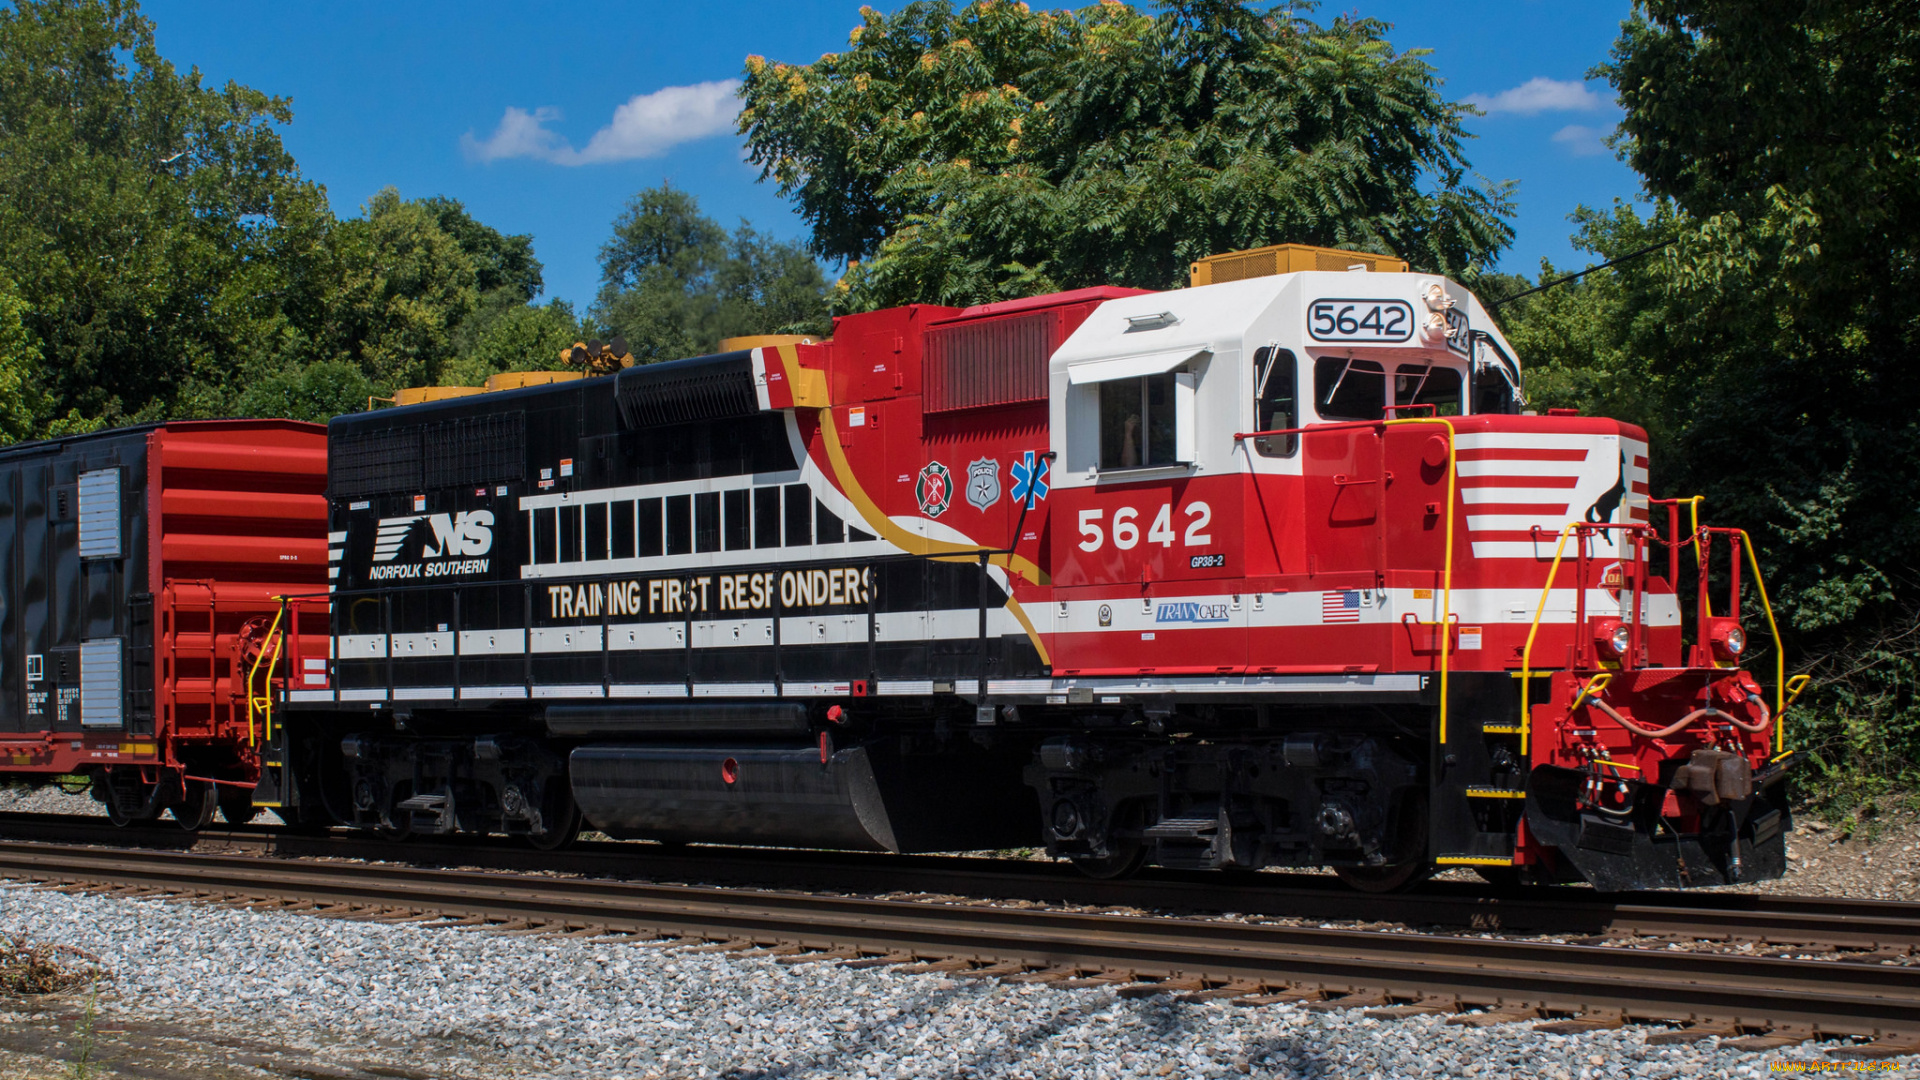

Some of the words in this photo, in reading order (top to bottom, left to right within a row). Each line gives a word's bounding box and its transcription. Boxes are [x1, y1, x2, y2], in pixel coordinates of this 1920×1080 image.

[1314, 305, 1406, 336] 5642
[929, 464, 940, 473] FIRE
[973, 467, 994, 479] POLICE
[929, 506, 940, 515] DEPT
[1078, 501, 1211, 552] 5642
[1191, 555, 1224, 568] GP38-2
[369, 564, 422, 580] NORFOLK
[424, 559, 490, 577] SOUTHERN
[548, 580, 641, 618] TRAINING
[649, 576, 711, 614] FIRST
[1421, 676, 1430, 690] F
